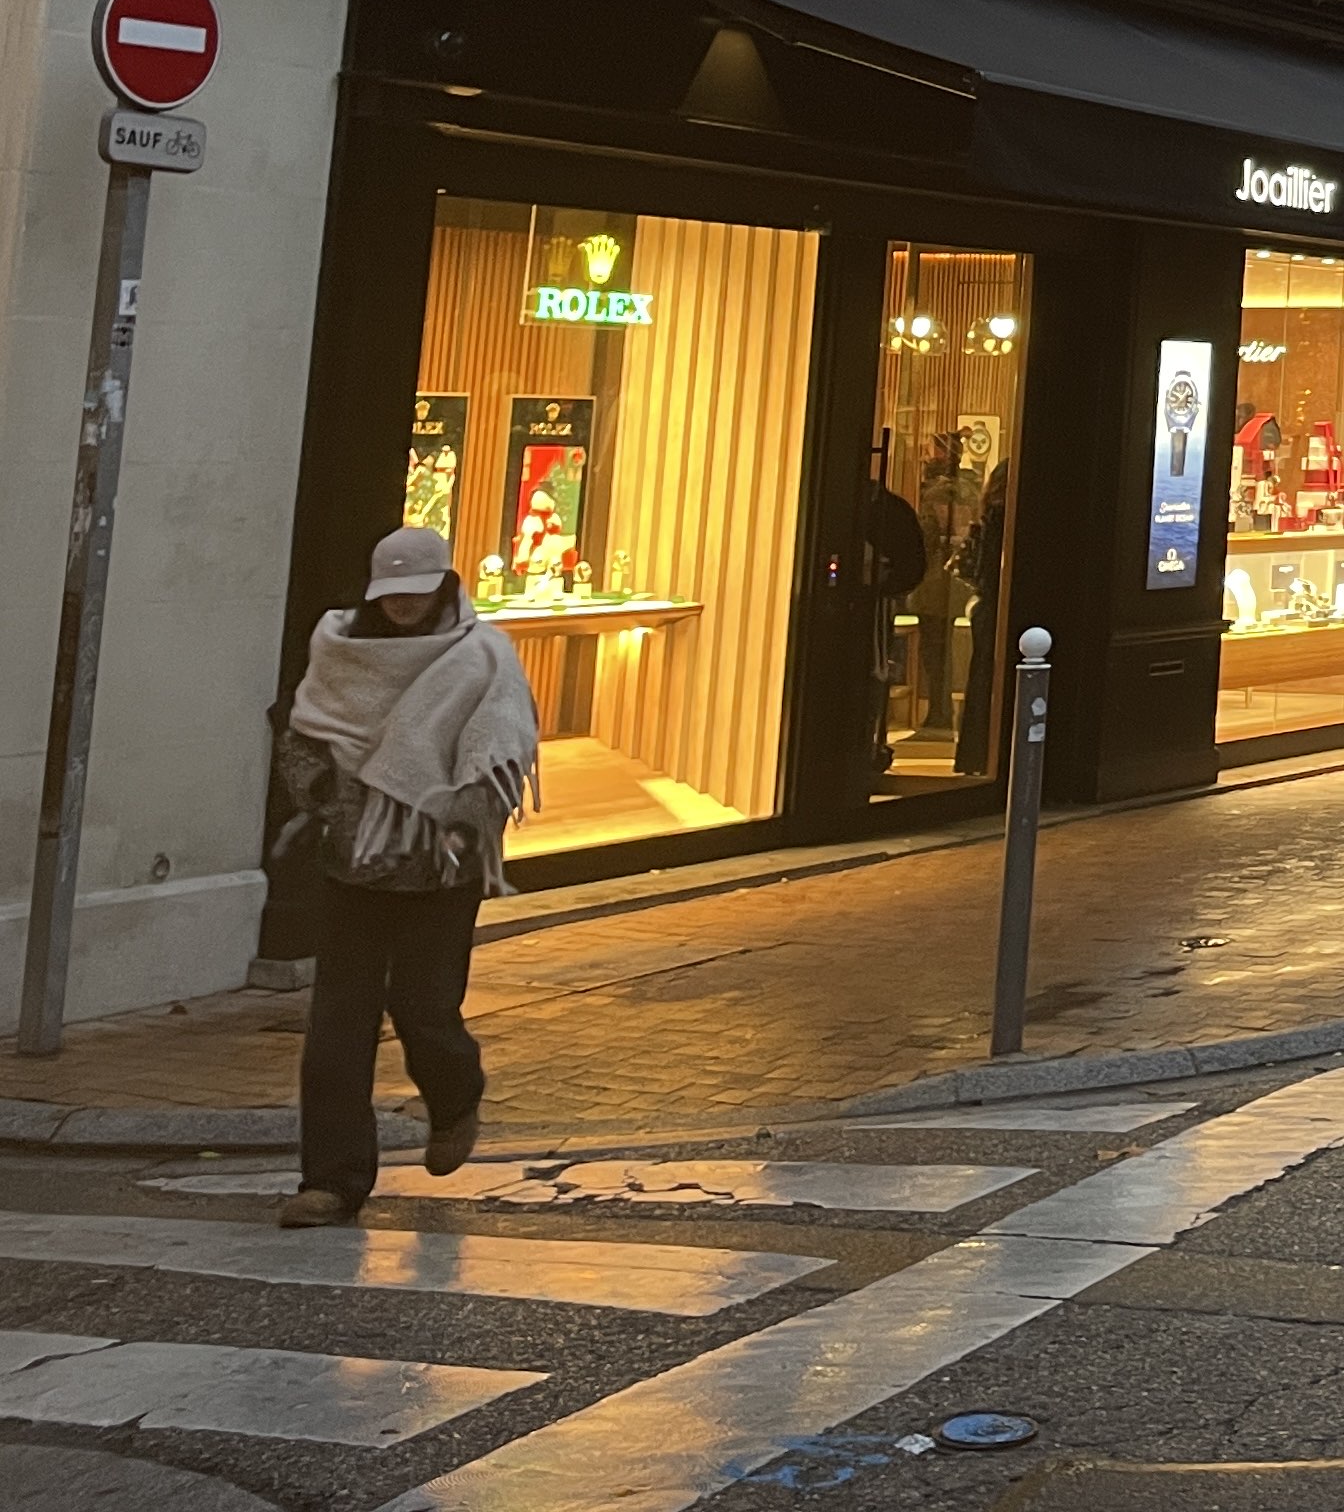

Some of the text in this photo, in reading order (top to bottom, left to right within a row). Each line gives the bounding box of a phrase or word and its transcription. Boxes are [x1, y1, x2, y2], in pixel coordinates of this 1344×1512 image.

[114, 126, 163, 149] SAUF
[1235, 158, 1336, 213] Joaillier
[535, 287, 654, 324] ROLEX
